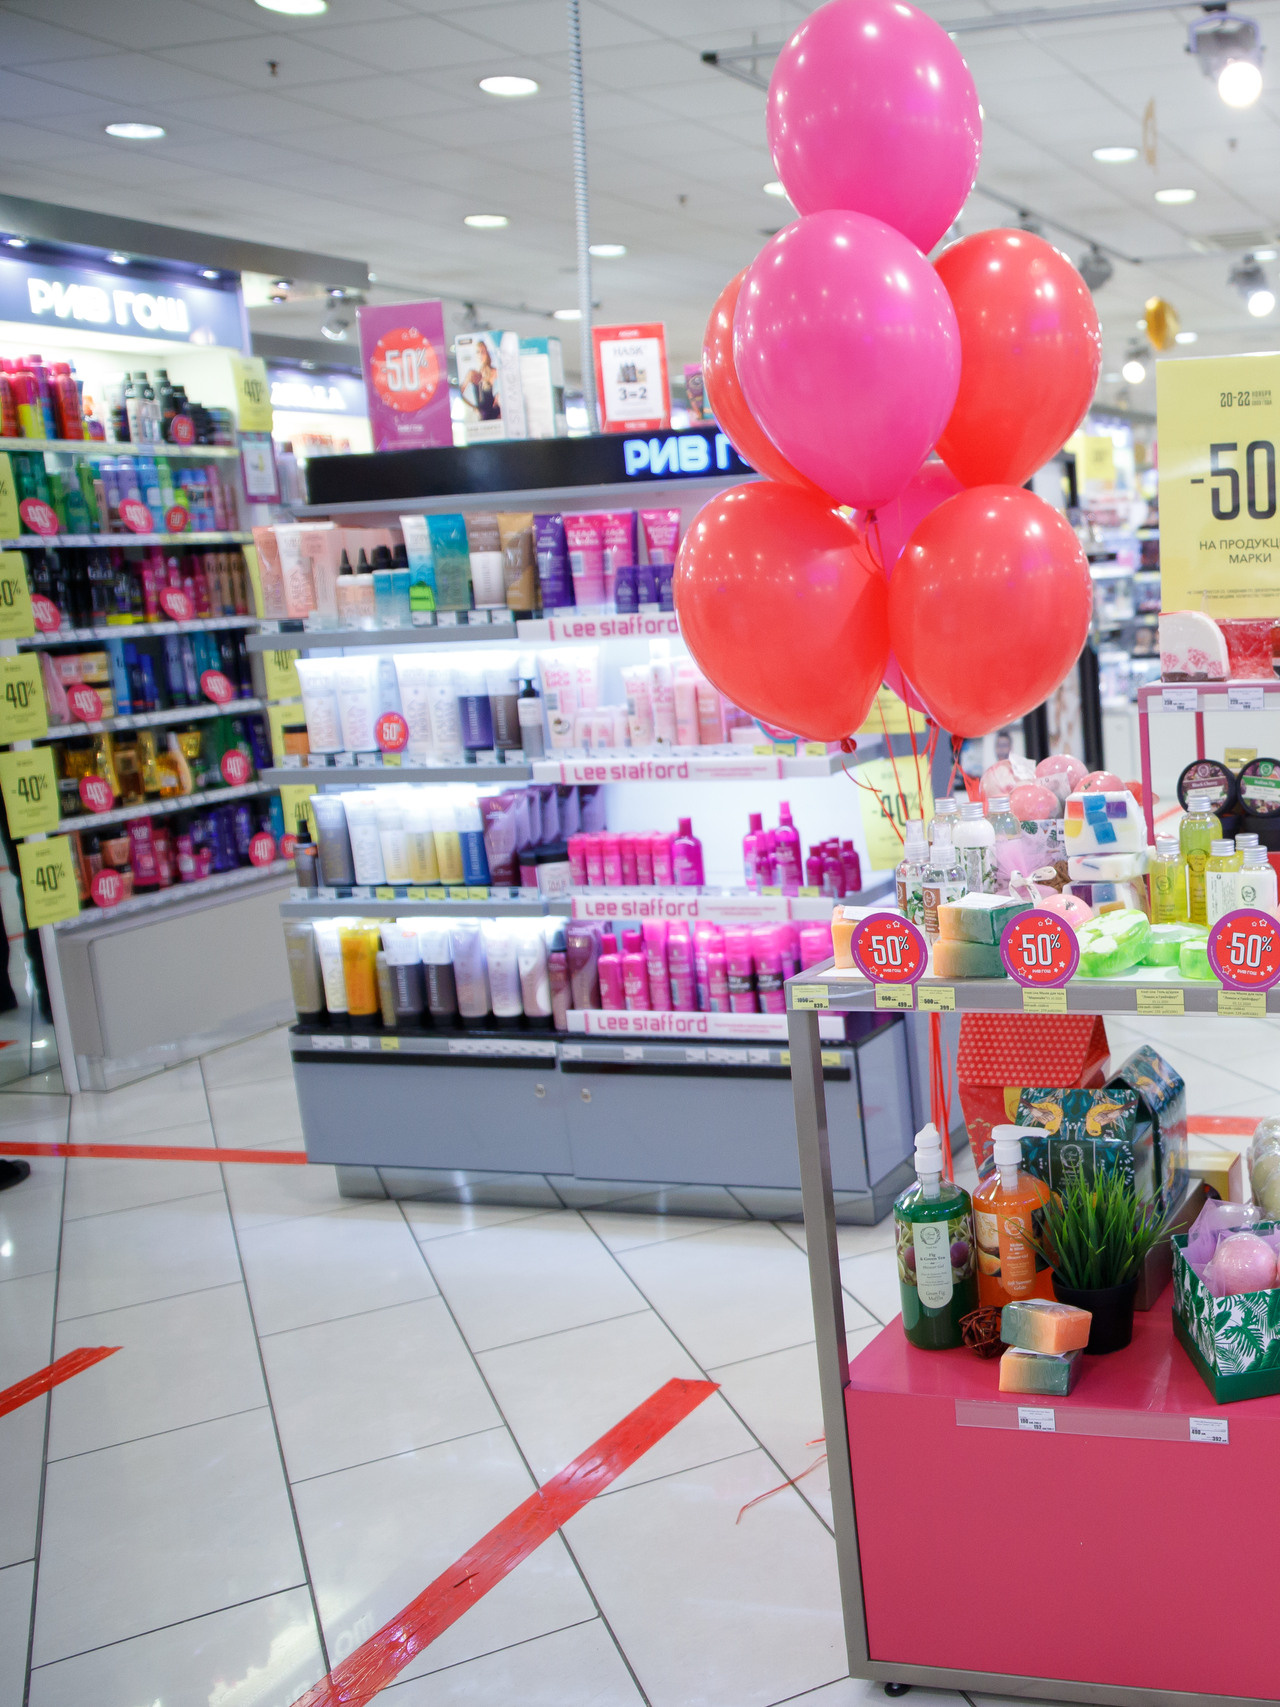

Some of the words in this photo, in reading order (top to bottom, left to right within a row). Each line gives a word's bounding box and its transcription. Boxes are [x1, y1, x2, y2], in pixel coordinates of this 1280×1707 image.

[27, 278, 111, 323] РИВ
[113, 290, 190, 333] ГОШ
[380, 346, 429, 393] -50%
[618, 386, 648, 402] 3=2
[1220, 391, 1251, 408] 20-22
[623, 434, 710, 476] РИВ
[1199, 540, 1217, 551] НА
[1228, 553, 1272, 564] МАРКИ
[0, 576, 22, 606] 0%
[563, 619, 596, 638] Lee
[574, 765, 607, 781] Lee
[610, 761, 690, 780] stafford
[12, 773, 48, 802] -40%
[585, 901, 618, 917] Lee
[621, 898, 699, 917] stafford
[868, 935, 910, 966] -50%
[1017, 933, 1061, 966] -50%
[1225, 931, 1273, 968] -50%
[597, 1016, 629, 1033] Lee
[632, 1014, 709, 1034] stafford
